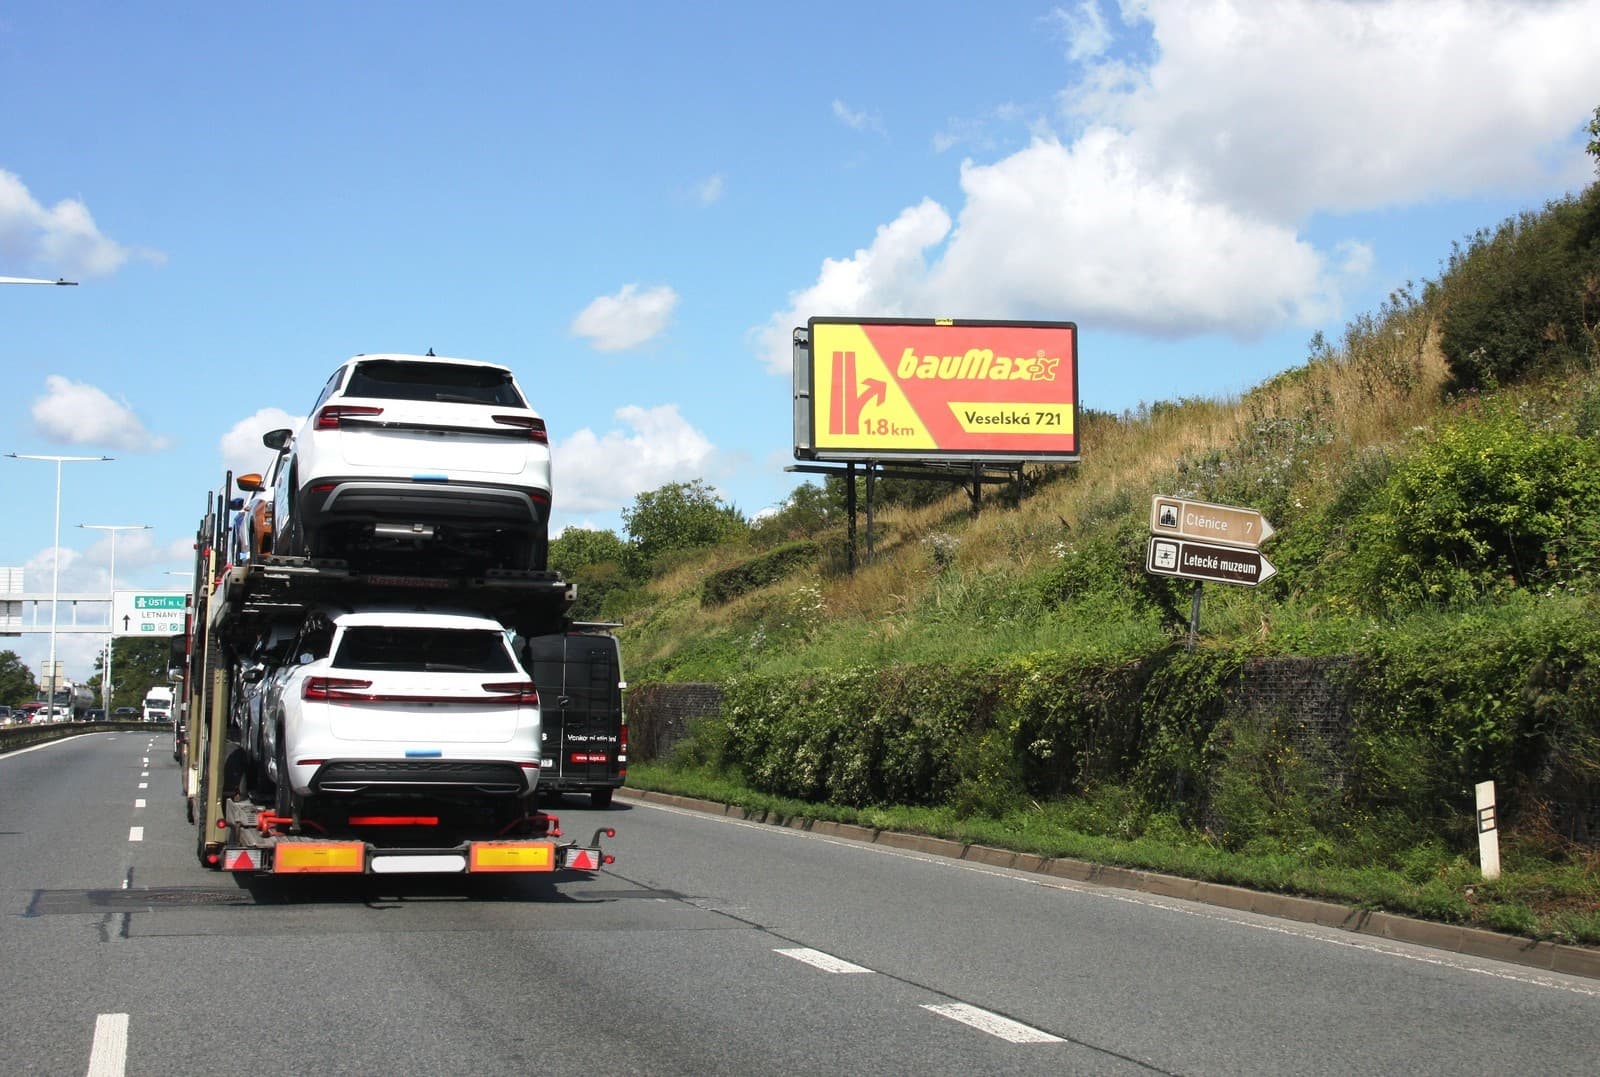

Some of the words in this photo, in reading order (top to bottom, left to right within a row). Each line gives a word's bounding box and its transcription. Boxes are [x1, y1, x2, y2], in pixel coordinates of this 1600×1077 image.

[965, 411, 1031, 425] Veselská
[1035, 412, 1062, 426] 721
[864, 418, 889, 436] 1.8
[891, 423, 915, 437] km
[1246, 521, 1254, 535] 7
[1183, 552, 1219, 570] Letecké
[1219, 560, 1257, 575] muzeum
